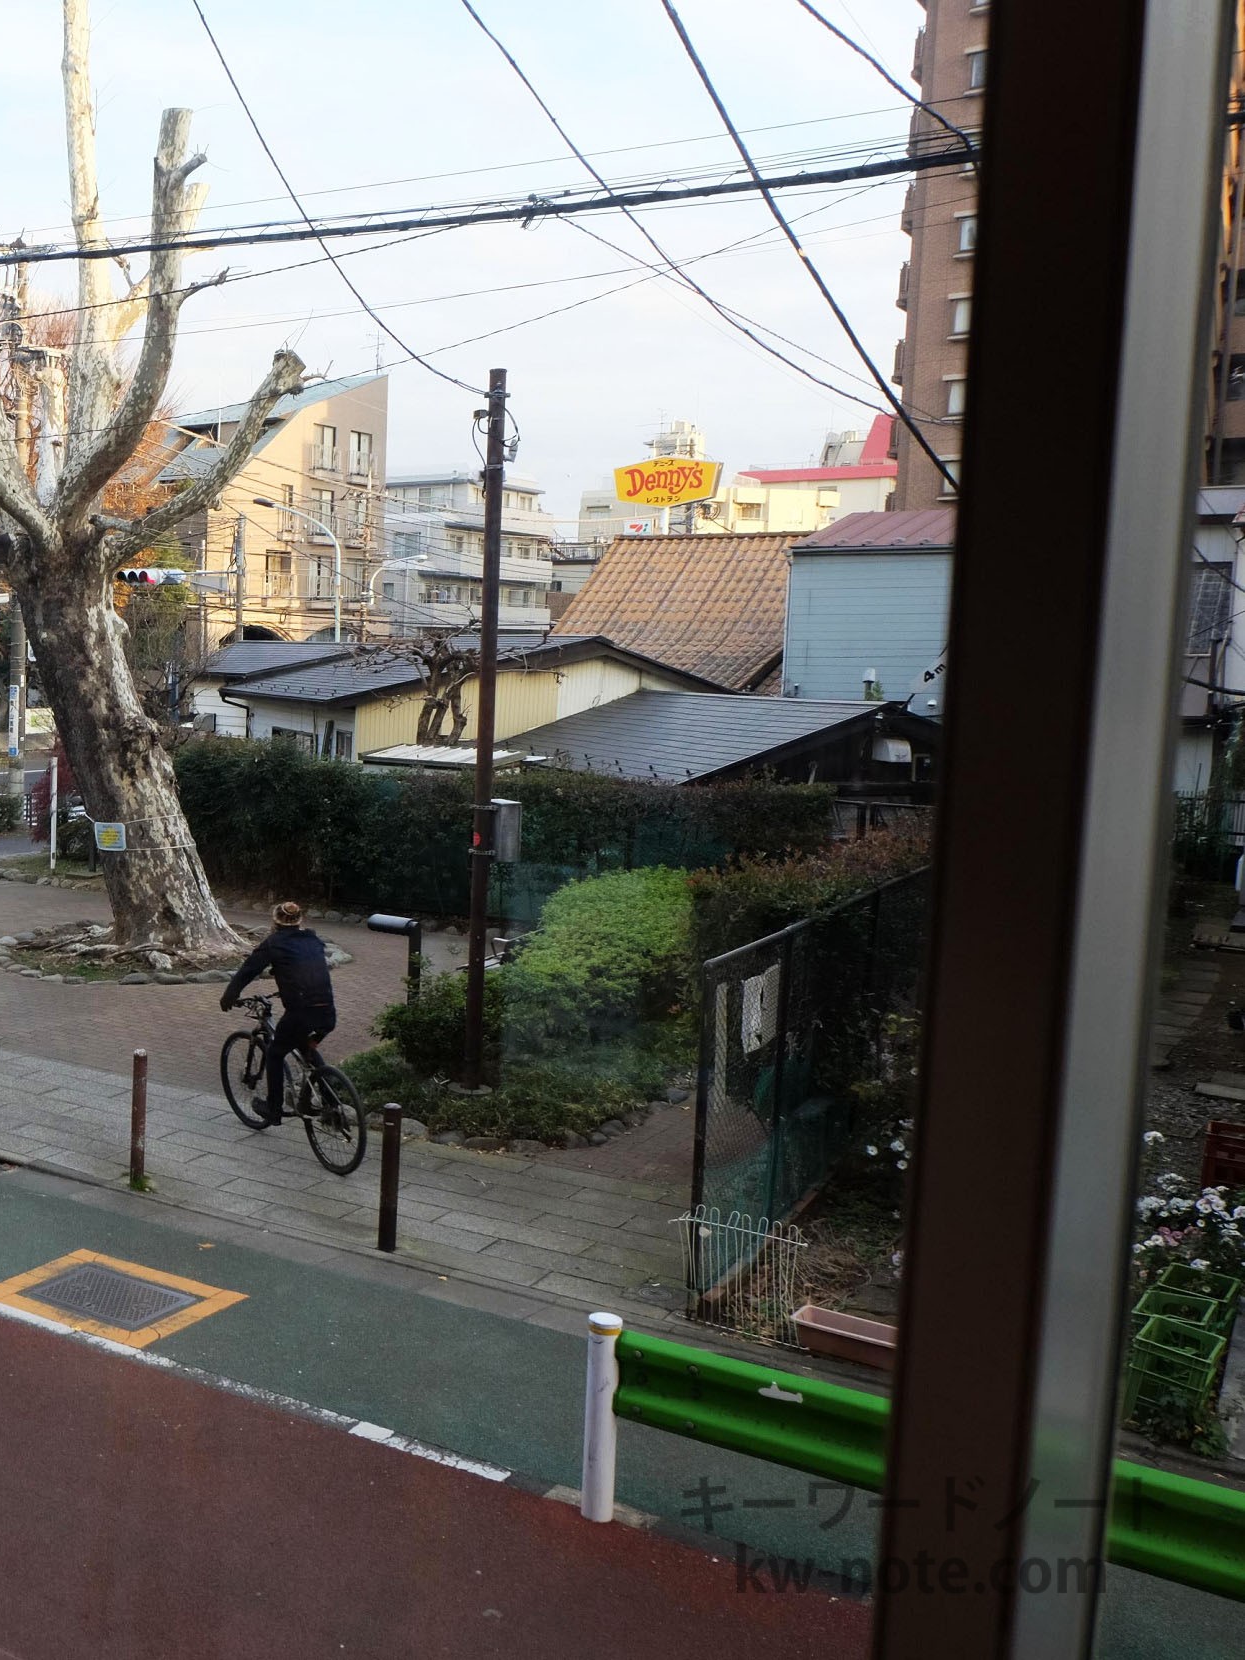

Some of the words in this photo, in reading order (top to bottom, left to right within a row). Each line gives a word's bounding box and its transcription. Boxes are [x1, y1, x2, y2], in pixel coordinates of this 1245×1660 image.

[625, 461, 703, 497] Denny's
[646, 495, 681, 504] レストラン
